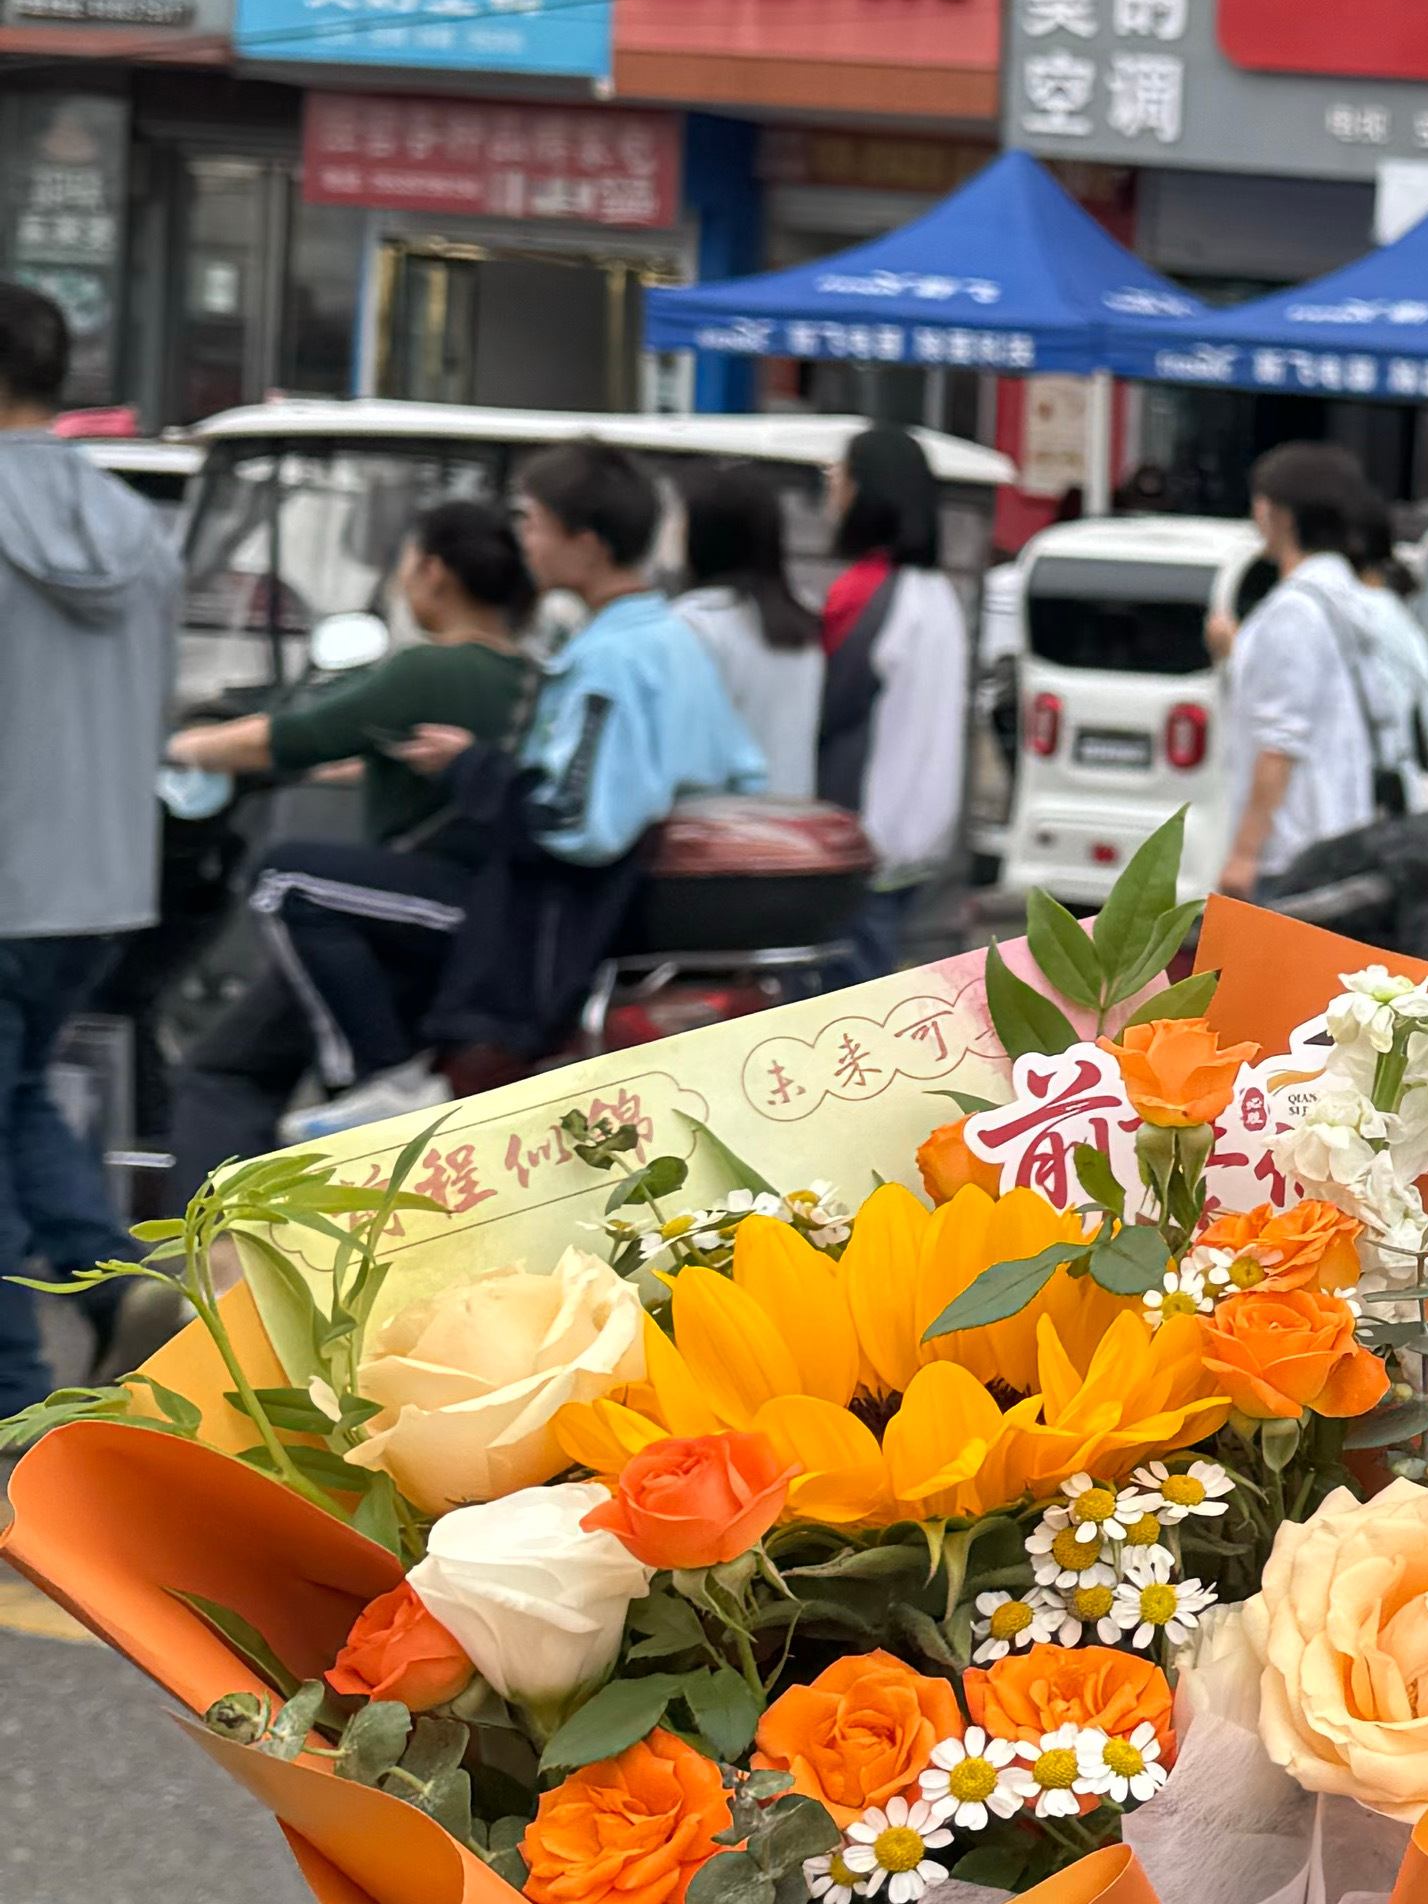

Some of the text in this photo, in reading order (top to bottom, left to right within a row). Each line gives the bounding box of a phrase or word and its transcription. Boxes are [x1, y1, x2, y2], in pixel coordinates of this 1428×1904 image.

[1021, 48, 1184, 143] 空调
[766, 1009, 998, 1106] 未来可
